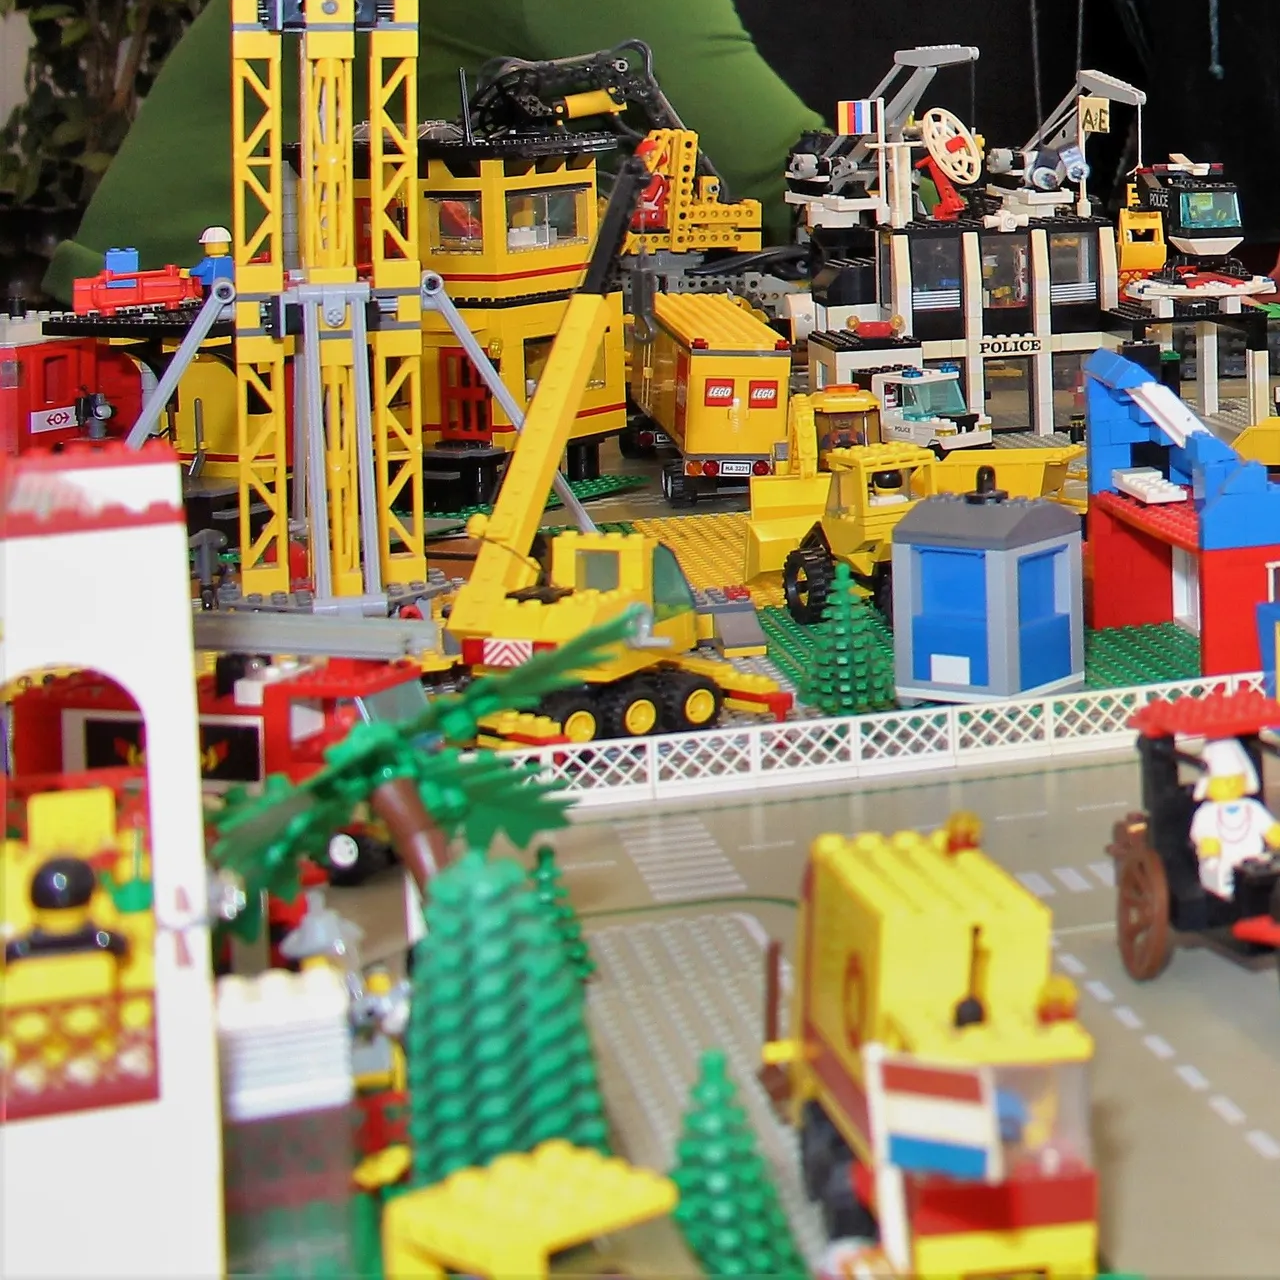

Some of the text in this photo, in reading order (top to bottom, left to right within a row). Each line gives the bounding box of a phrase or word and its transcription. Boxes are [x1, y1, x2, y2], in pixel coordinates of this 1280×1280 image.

[1150, 192, 1169, 207] POLICE
[979, 339, 1041, 354] POLICE
[706, 385, 733, 399] LEGO
[751, 387, 776, 400] LEGO
[894, 425, 911, 434] POLICE
